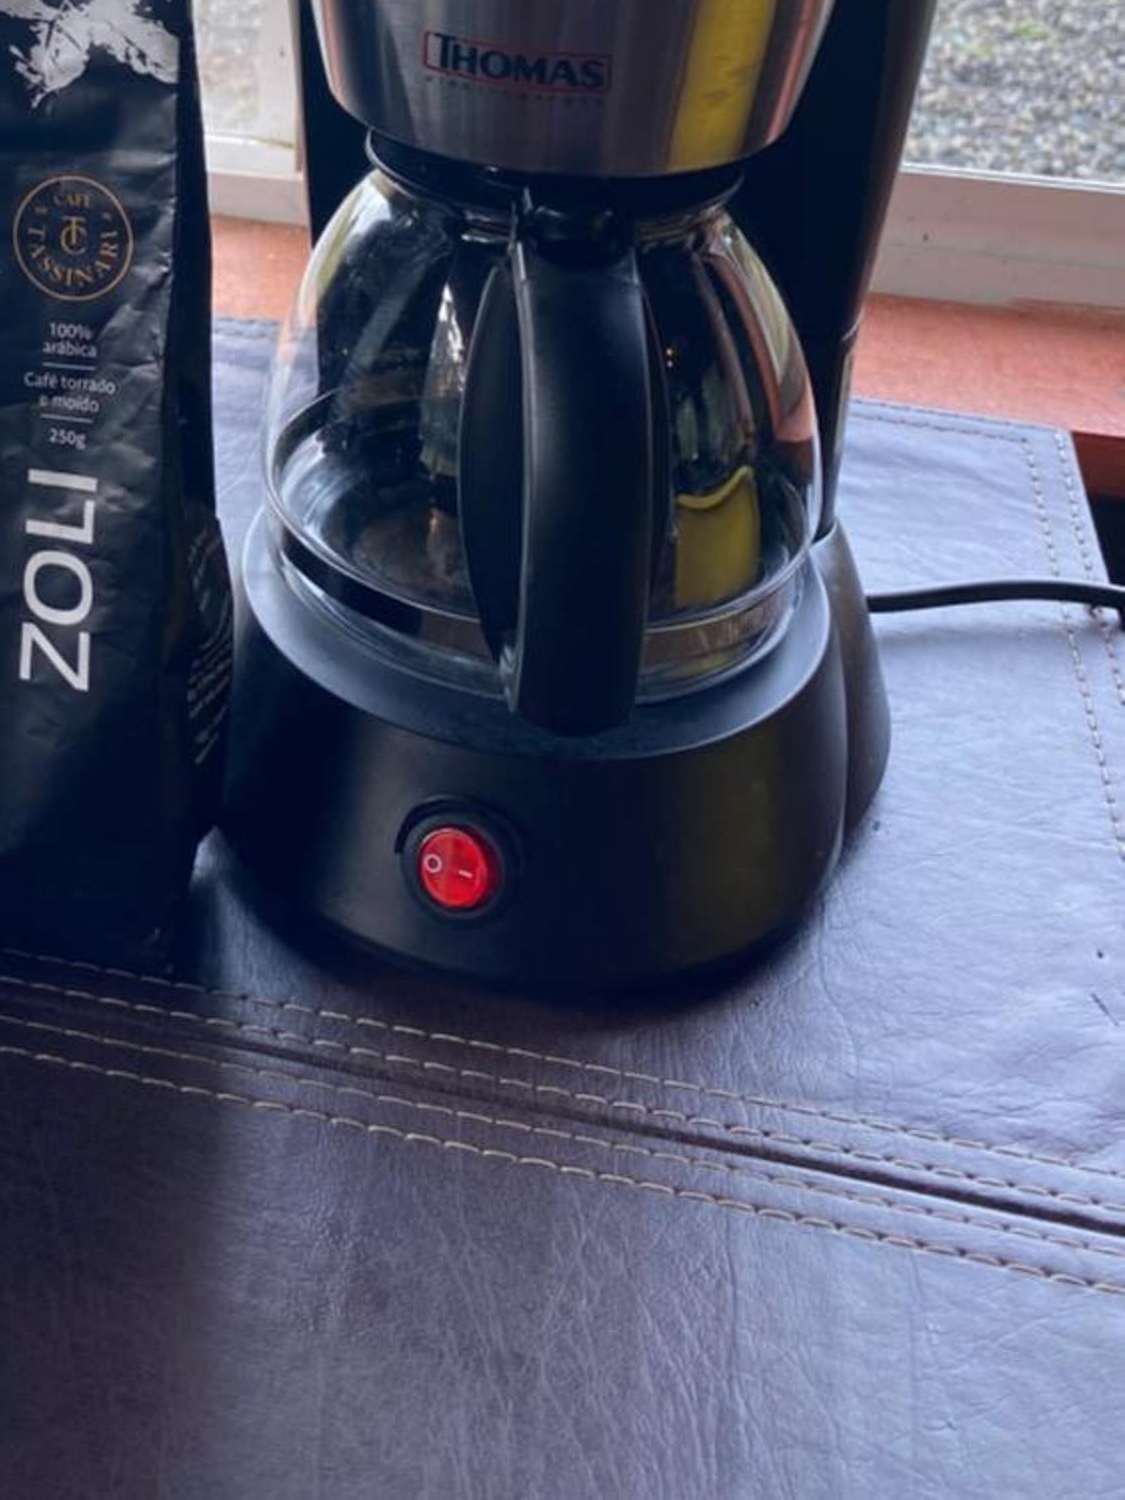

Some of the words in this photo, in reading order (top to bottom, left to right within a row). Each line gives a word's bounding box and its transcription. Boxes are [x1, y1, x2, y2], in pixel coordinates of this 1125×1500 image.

[434, 32, 604, 89] THOMAS
[49, 323, 92, 341] 100%
[60, 376, 116, 396] torrado
[49, 427, 86, 450] 250g
[19, 467, 99, 693] ZOLI
